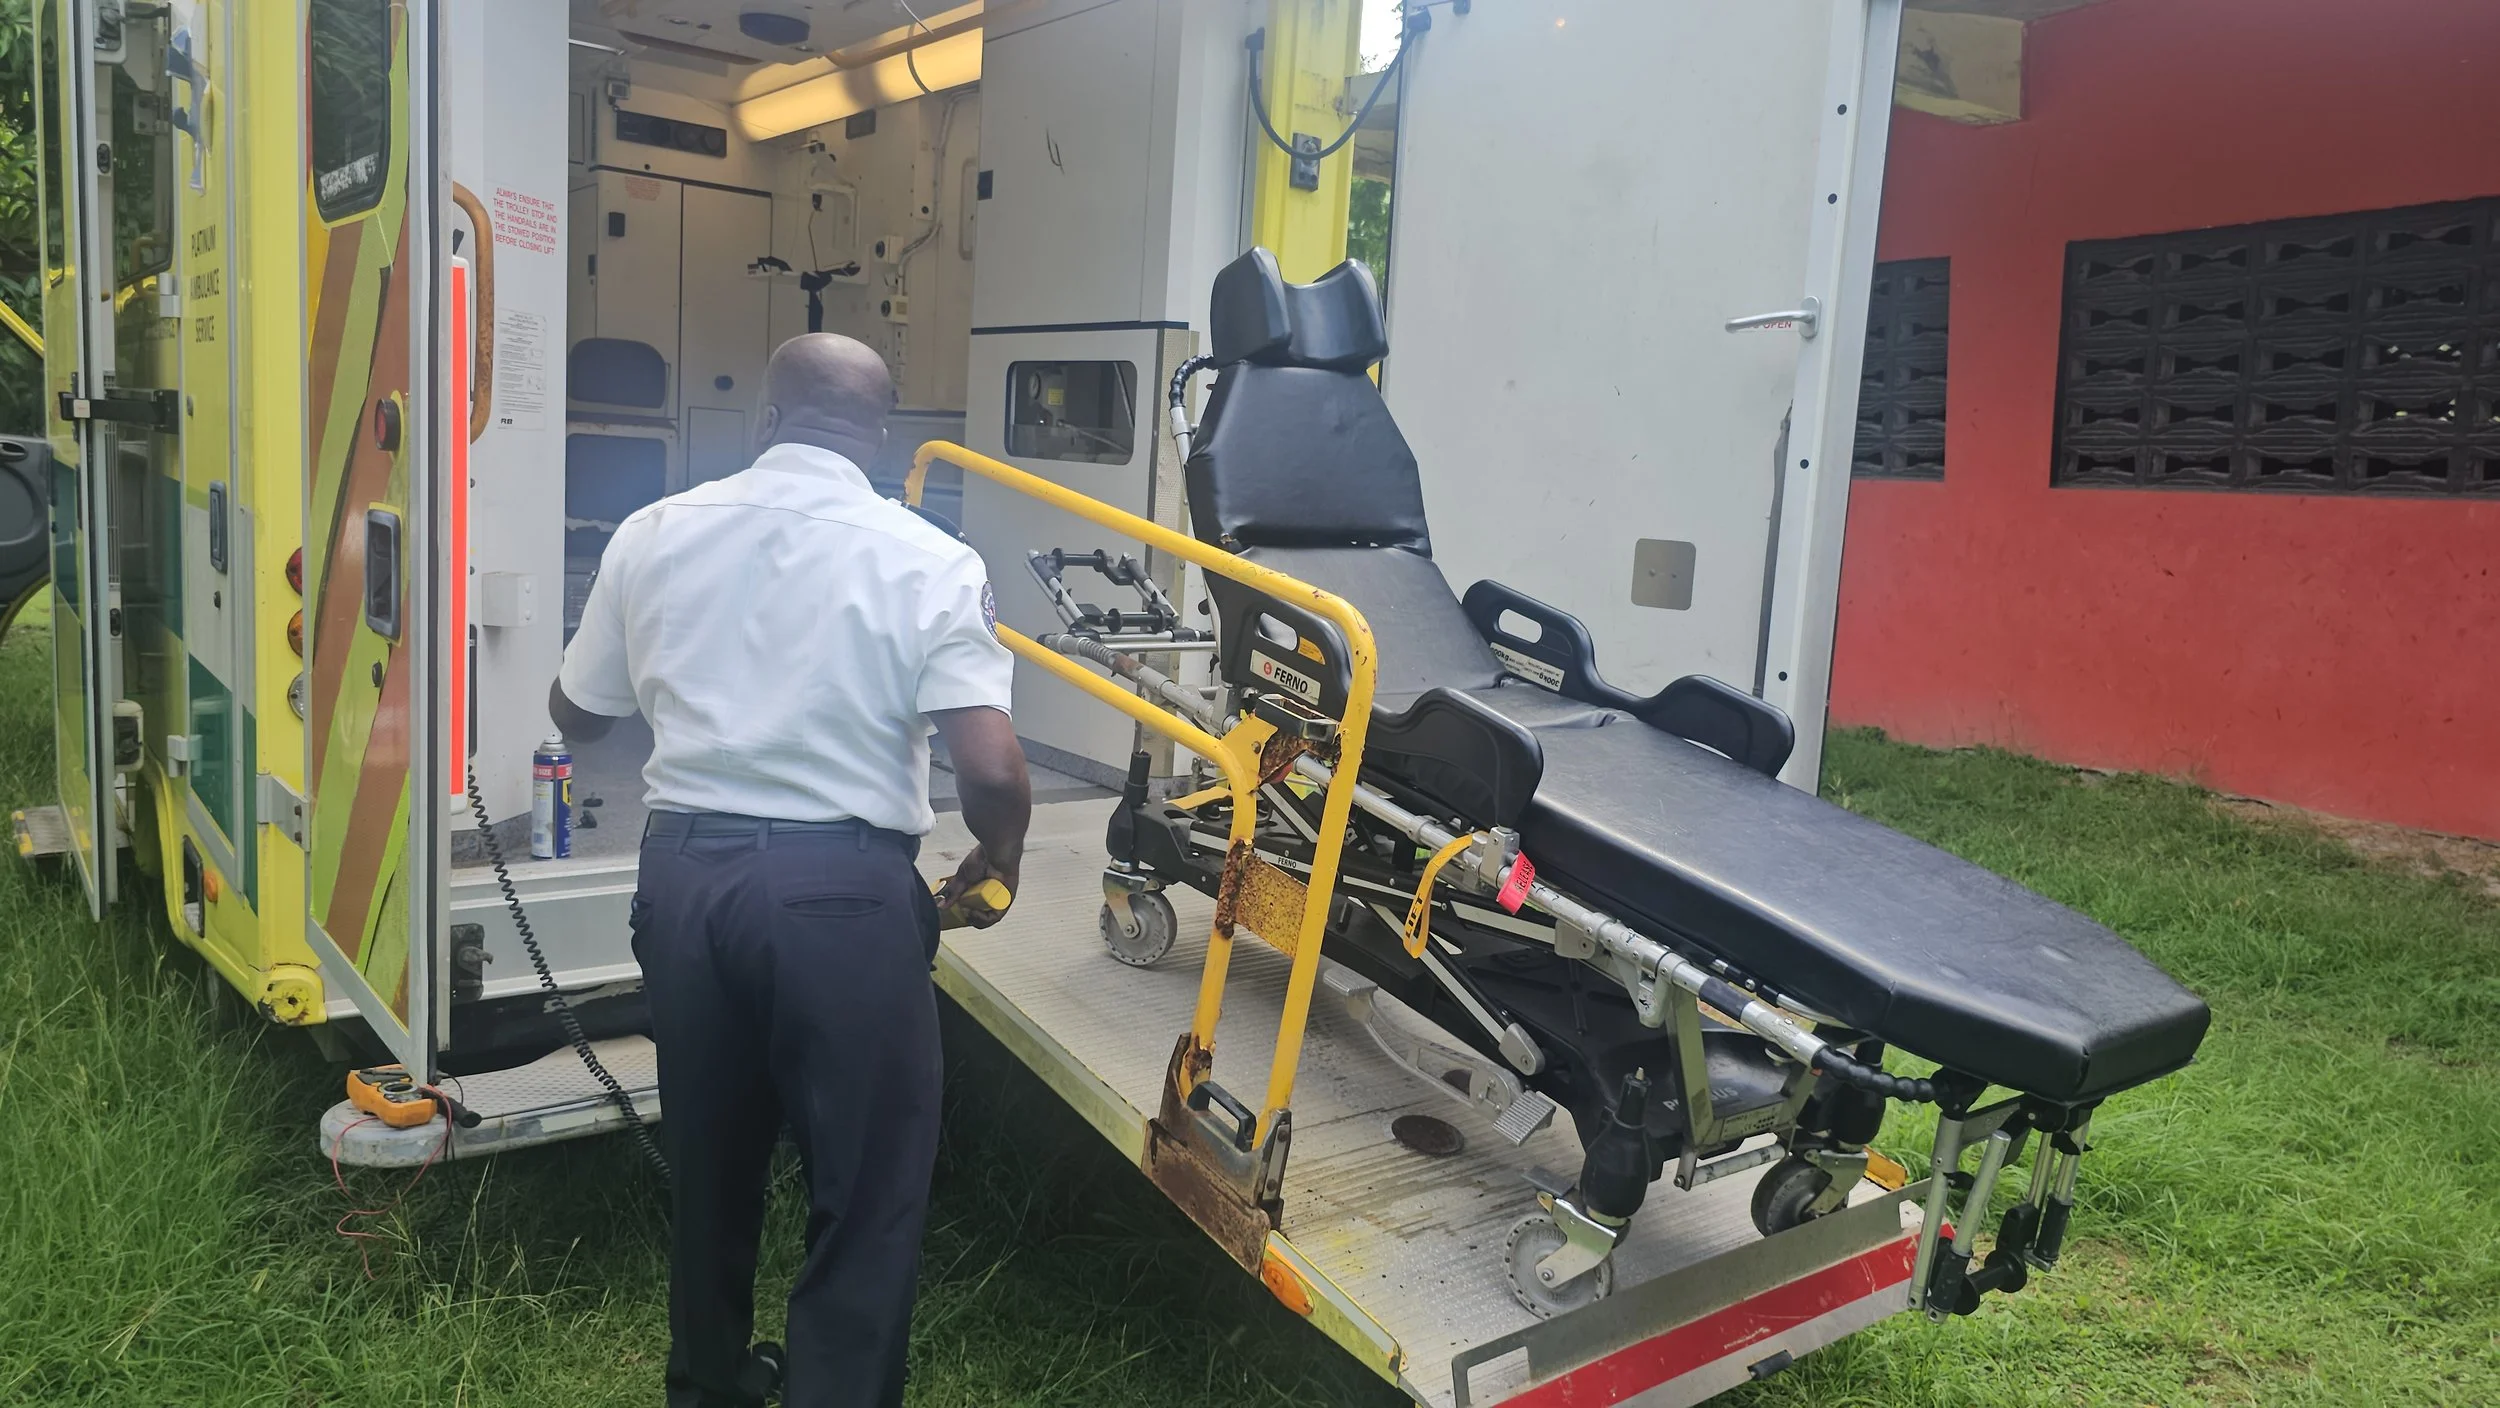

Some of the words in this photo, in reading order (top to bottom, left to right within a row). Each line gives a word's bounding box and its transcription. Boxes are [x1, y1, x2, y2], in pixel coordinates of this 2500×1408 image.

[493, 198, 504, 208] THE
[506, 202, 529, 215] TROLLEY
[531, 209, 545, 219] STOP
[547, 214, 557, 223] AND
[496, 187, 517, 201] ALWAYS
[519, 194, 541, 207] ENSURE
[542, 201, 555, 211] THAT
[495, 210, 505, 220] THE
[507, 213, 537, 229] HANDRAILS
[539, 222, 549, 232] ARE
[495, 221, 505, 232] THE
[508, 225, 530, 238] STOWED
[531, 231, 556, 245] POSITION
[191, 224, 216, 258] PLATINUM
[495, 233, 517, 246] BEFORE
[519, 240, 543, 252] CLOSING
[544, 246, 555, 255] LIFT
[190, 268, 219, 299] AMBULANCE
[195, 315, 215, 343] SERVICE
[1763, 320, 1792, 329] OPEN
[1273, 667, 1308, 694] FERNO
[1538, 672, 1560, 687] 300kg
[1277, 857, 1297, 868] FERNO
[1405, 893, 1423, 939] LIFT
